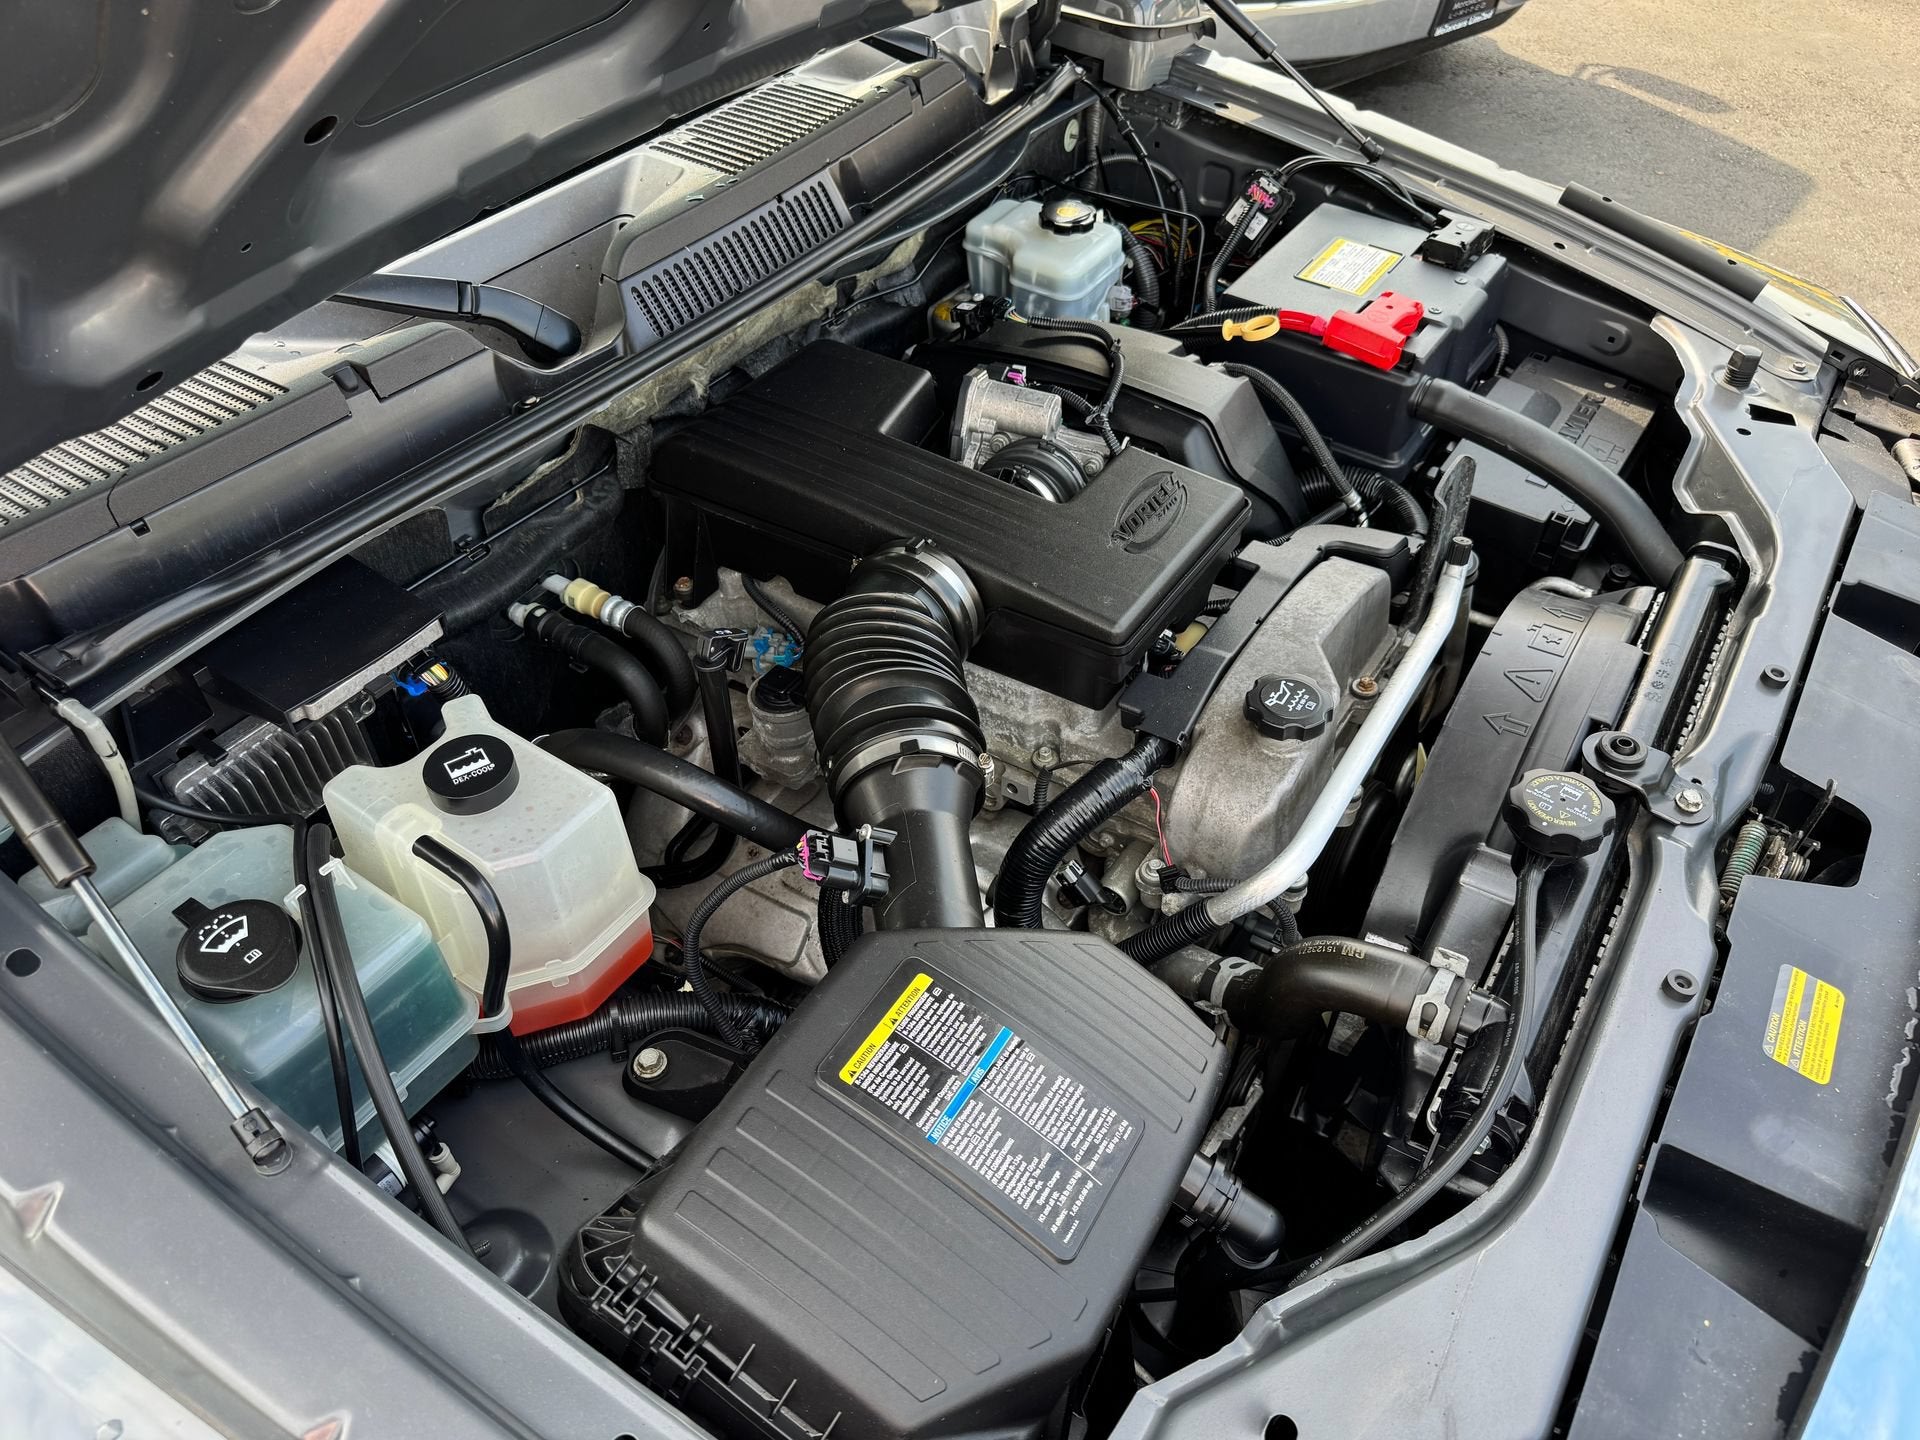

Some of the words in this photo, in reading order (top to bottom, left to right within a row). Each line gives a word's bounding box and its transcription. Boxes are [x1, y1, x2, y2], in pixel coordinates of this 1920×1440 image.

[1111, 474, 1178, 541] VORTEC
[1535, 809, 1553, 821] OPEN
[1553, 817, 1576, 827] NEVER
[894, 985, 921, 1017] ATTENTION
[1767, 1012, 1781, 1043] CAUTION
[1793, 1019, 1807, 1058] ATTENTION
[852, 1042, 876, 1069] CAUTION
[969, 1066, 985, 1083] AVIS
[930, 1114, 951, 1139] NOTICE
